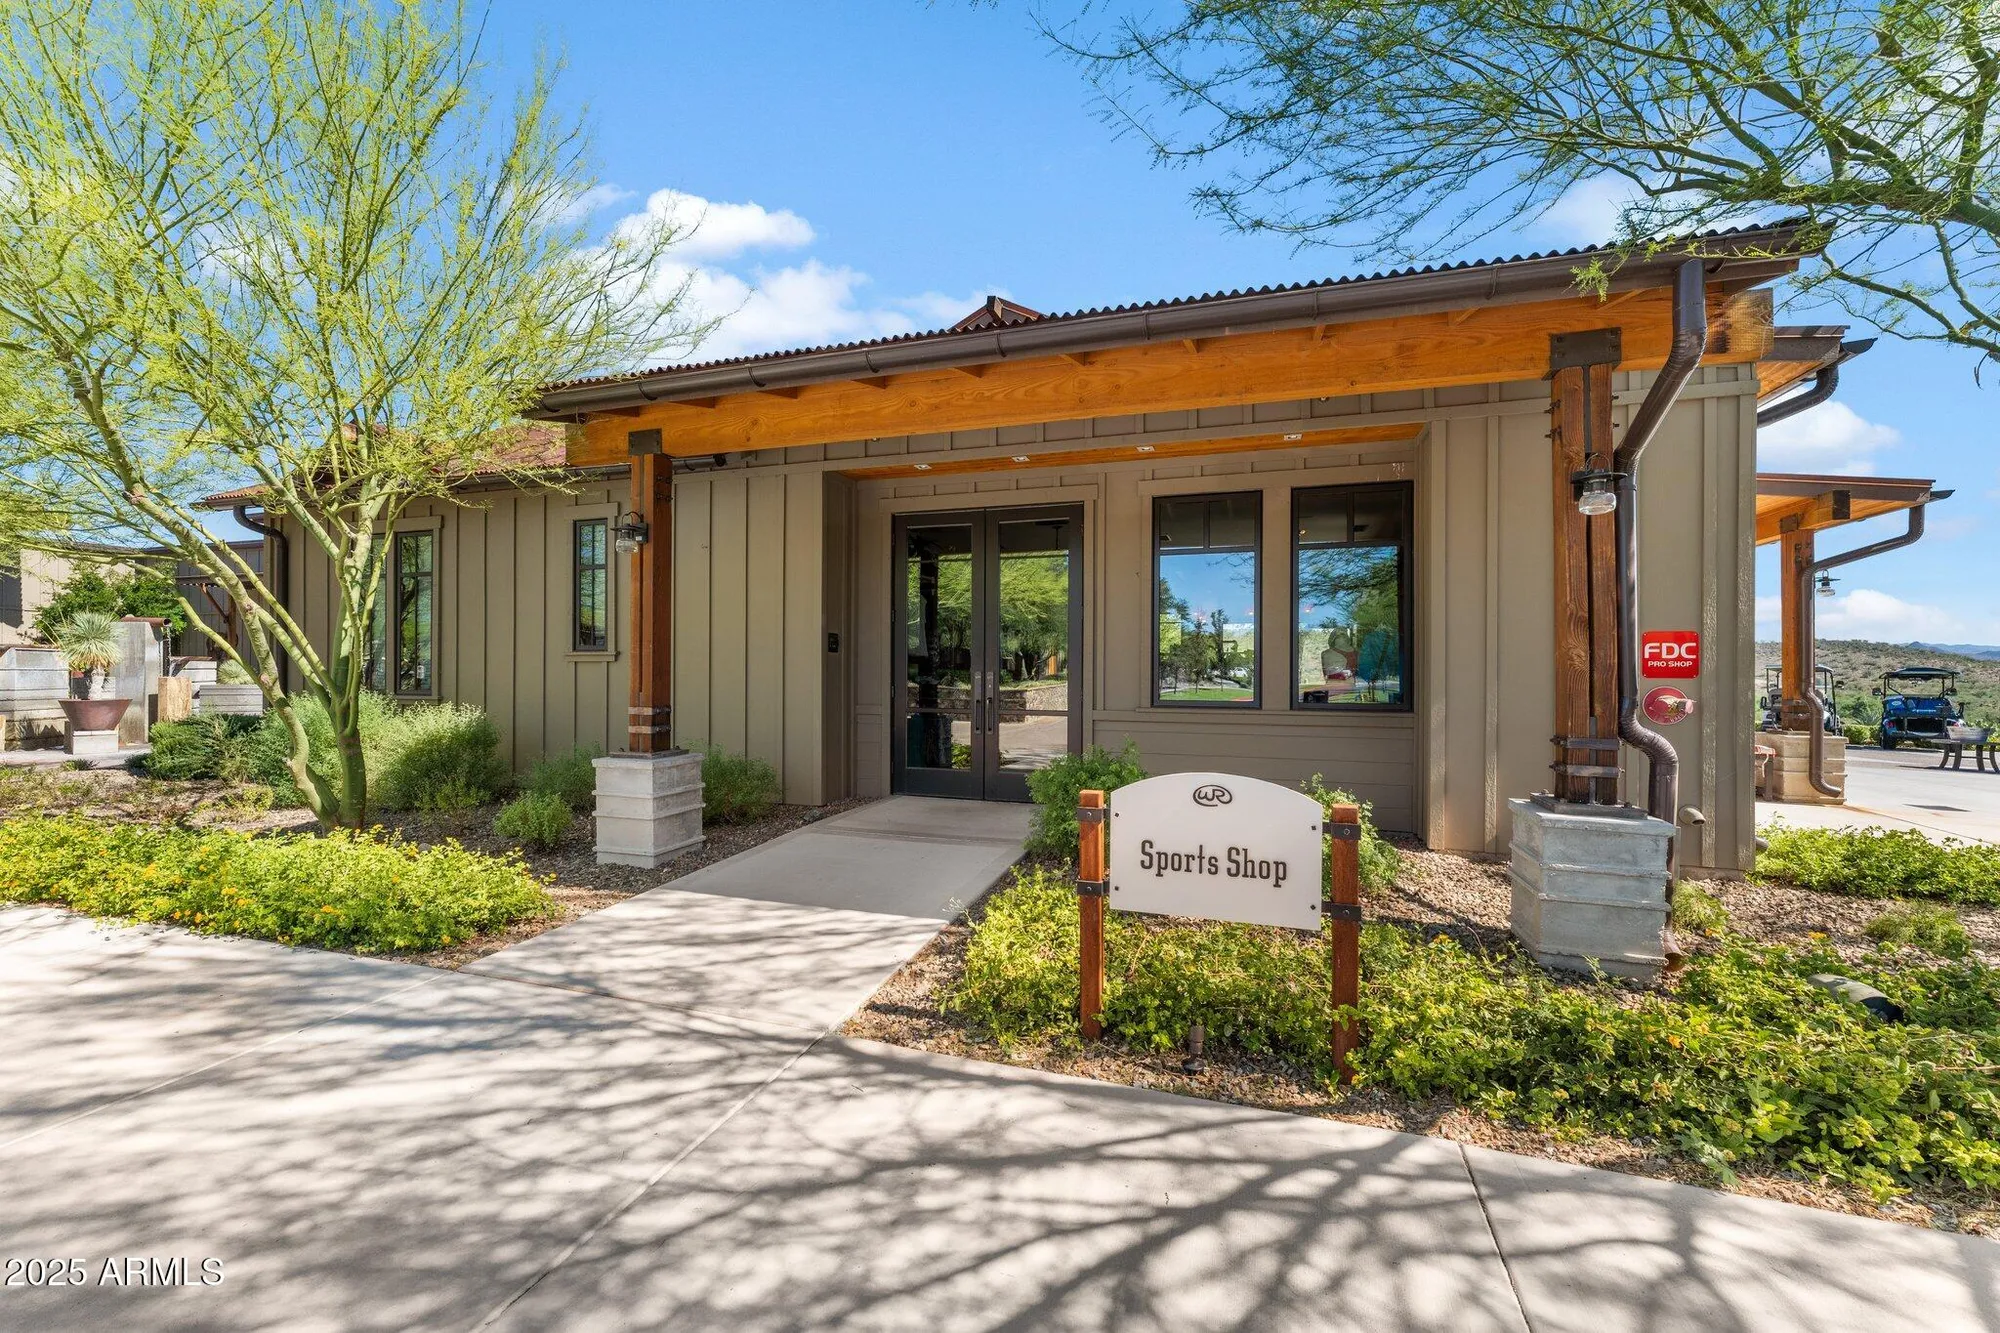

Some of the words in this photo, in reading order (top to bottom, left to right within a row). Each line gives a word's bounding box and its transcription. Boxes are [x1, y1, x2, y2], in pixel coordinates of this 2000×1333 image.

[1645, 643, 1697, 659] FDC
[1140, 839, 1219, 877] Sports
[1226, 846, 1287, 888] Shop
